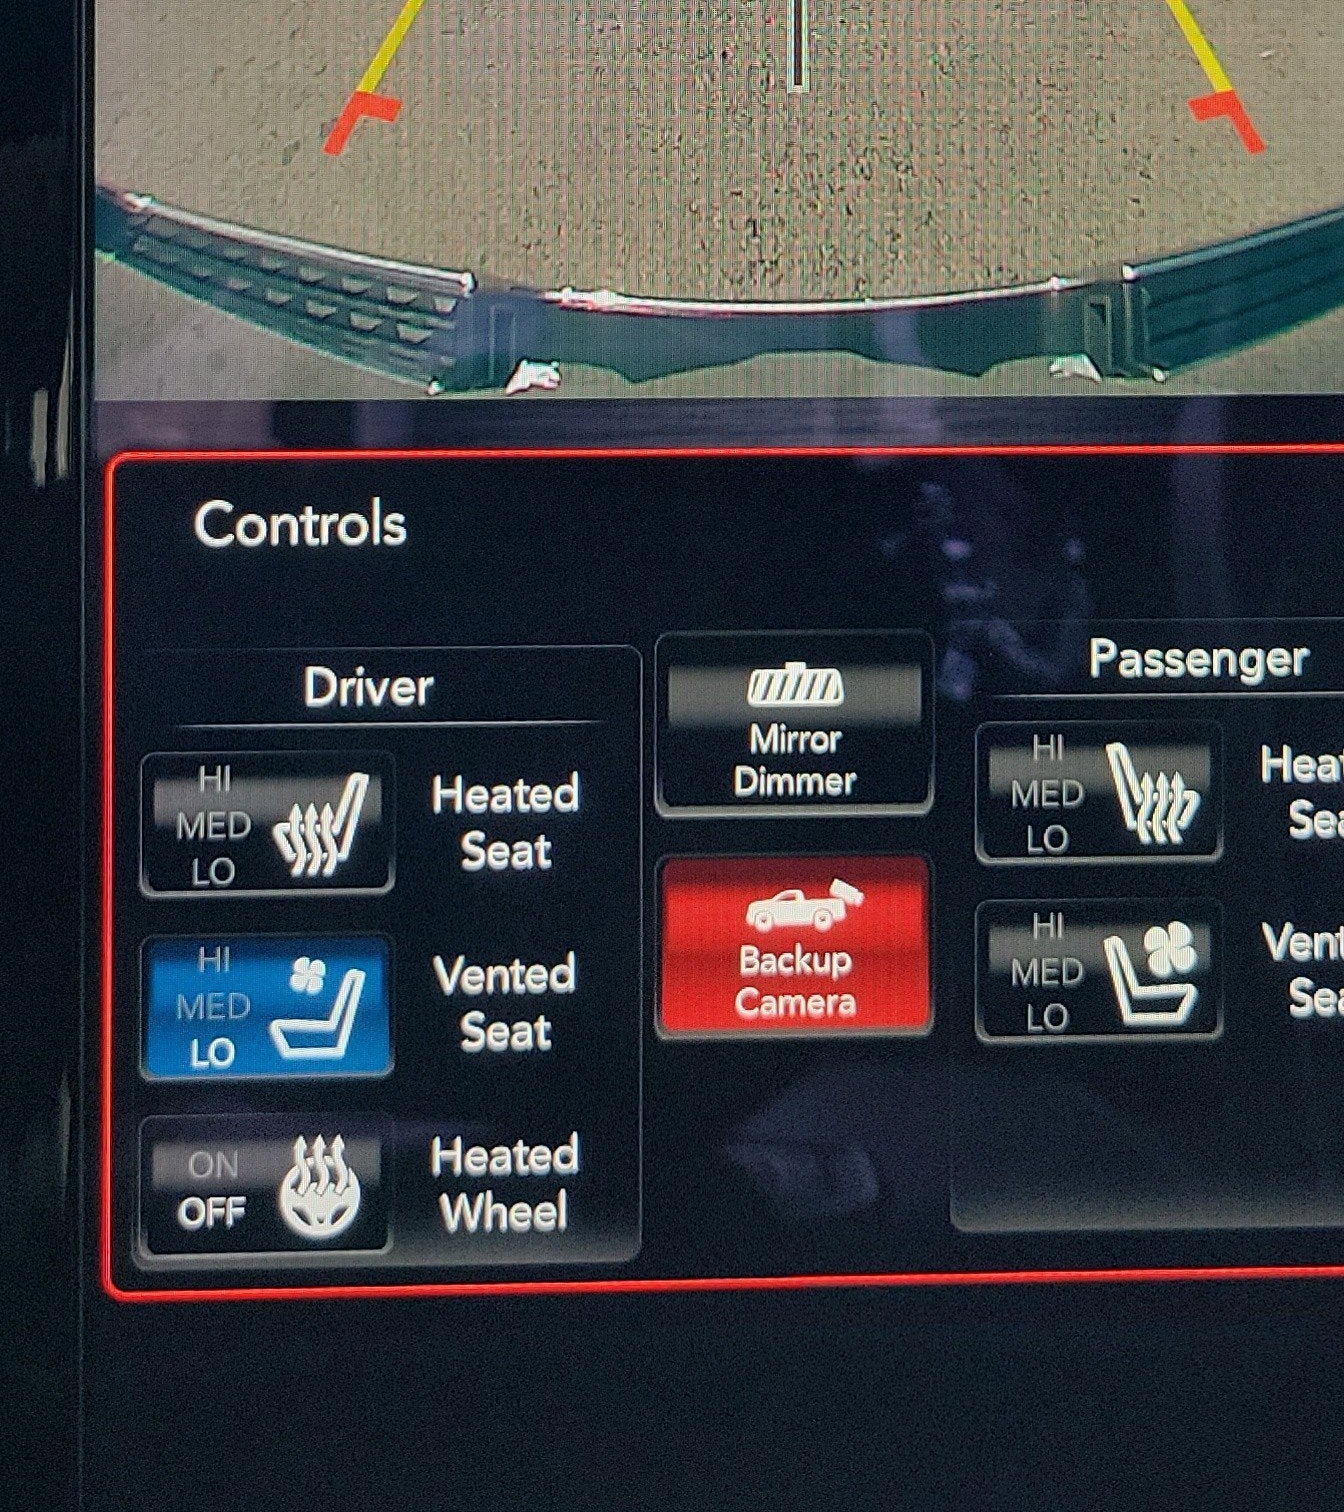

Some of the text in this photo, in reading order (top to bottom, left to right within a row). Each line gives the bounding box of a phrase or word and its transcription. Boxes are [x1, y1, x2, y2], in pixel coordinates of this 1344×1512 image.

[193, 496, 408, 548] Controls
[1089, 637, 1311, 686] Passenger
[304, 665, 435, 708] Driver
[749, 723, 843, 755] Mirror
[1032, 733, 1065, 762] HI
[198, 764, 232, 793] HI
[431, 770, 581, 815] Heated
[733, 764, 857, 798] Dimmer
[1011, 779, 1086, 809] MED
[176, 810, 253, 841] MED
[1026, 824, 1070, 855] LO
[460, 829, 553, 871] Seat
[191, 856, 236, 887] LO
[1032, 911, 1065, 940] HI
[197, 945, 231, 974] HI
[431, 950, 578, 996] Vented
[739, 942, 853, 982] Backup
[1011, 957, 1084, 987] MED
[176, 992, 252, 1021] MED
[734, 986, 857, 1019] Camera
[1026, 1002, 1070, 1033] LO
[460, 1010, 553, 1053] Seat
[190, 1037, 236, 1069] LO
[187, 1150, 240, 1180] ON
[431, 1131, 580, 1178] Heated
[177, 1195, 247, 1230] OFF
[438, 1188, 568, 1234] Wheel
